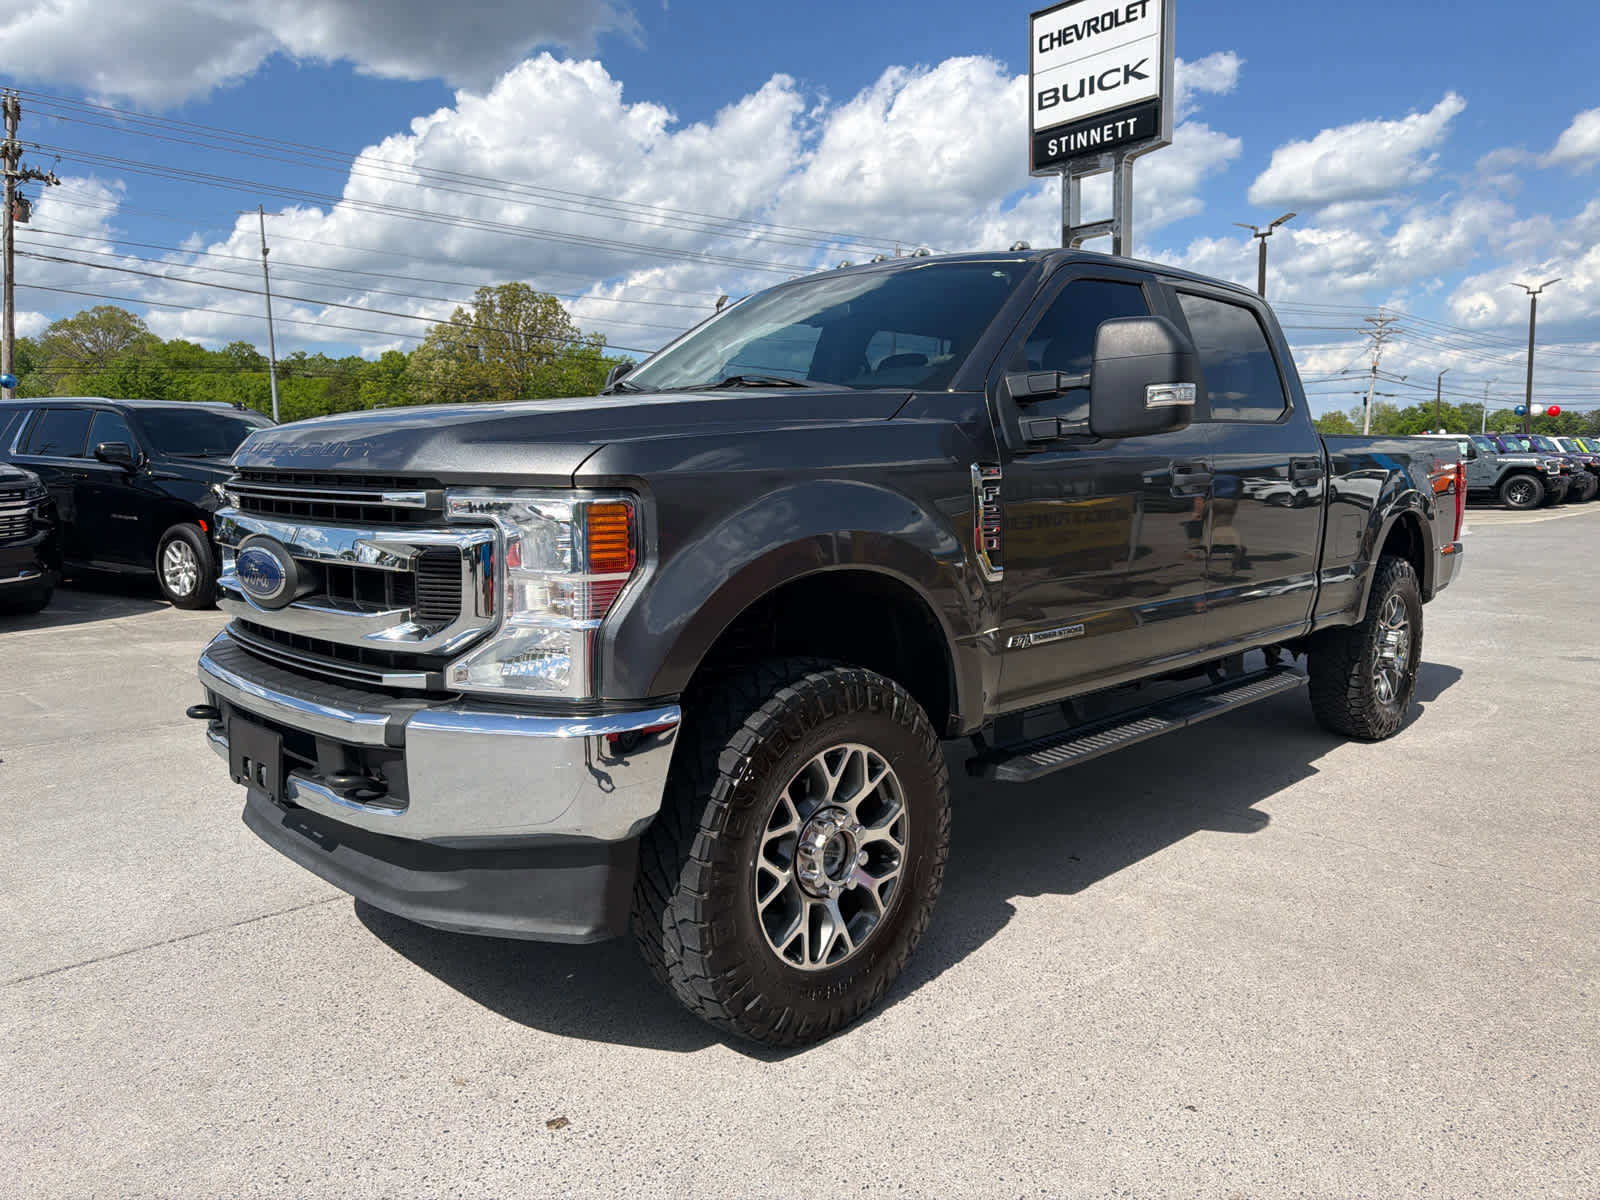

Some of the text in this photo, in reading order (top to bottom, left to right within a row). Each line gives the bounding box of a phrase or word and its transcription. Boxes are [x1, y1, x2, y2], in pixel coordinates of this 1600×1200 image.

[1038, 0, 1151, 54] CHEVROLET
[1037, 57, 1150, 111] BUICK
[1047, 118, 1138, 156] STINNETT
